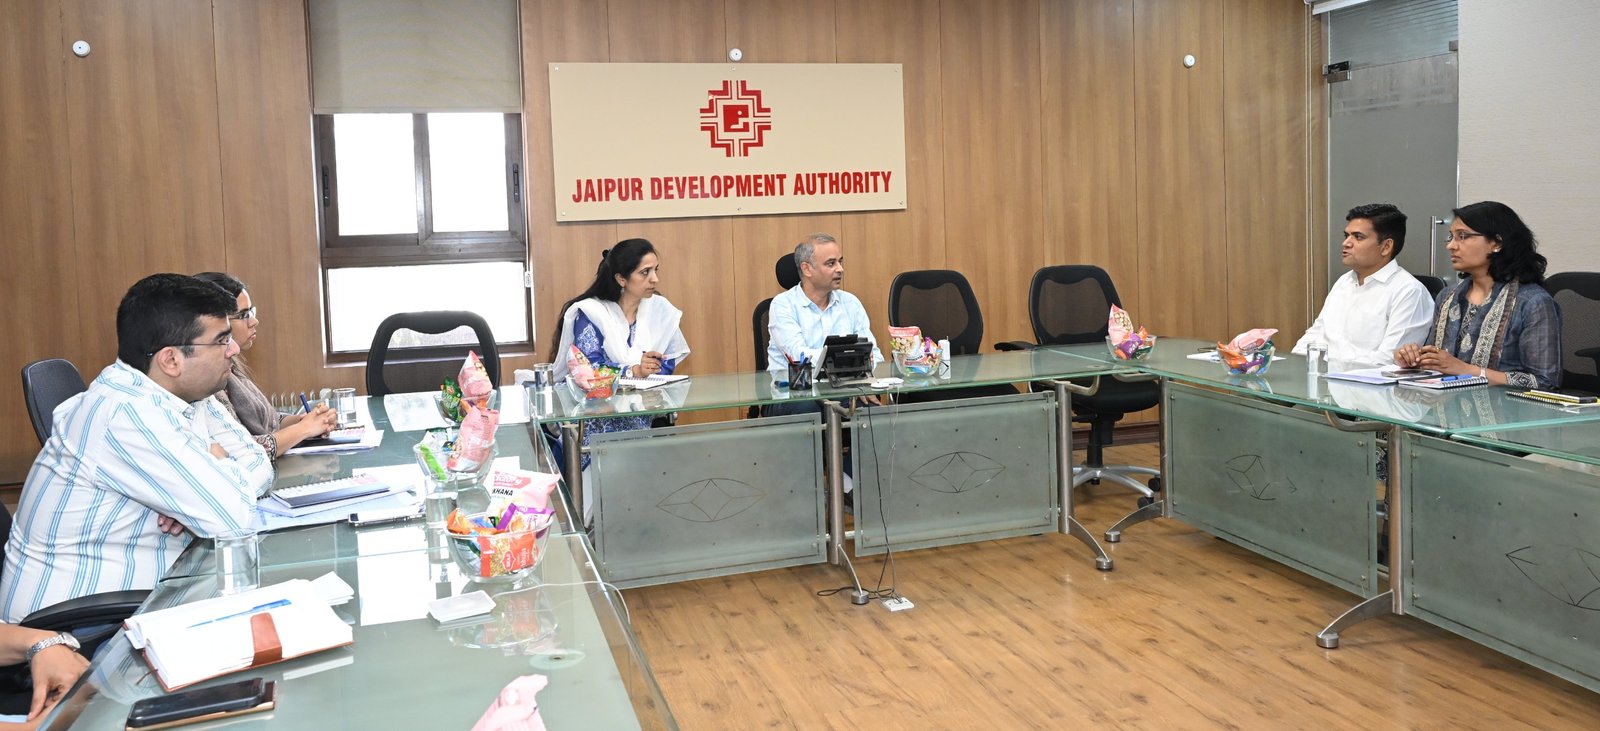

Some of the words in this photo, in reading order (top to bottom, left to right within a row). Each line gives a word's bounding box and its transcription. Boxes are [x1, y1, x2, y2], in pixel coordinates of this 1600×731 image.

[572, 177, 643, 203] JAIPUR
[650, 173, 787, 200] DEVELOPMENT
[793, 171, 892, 196] AUTHORITY
